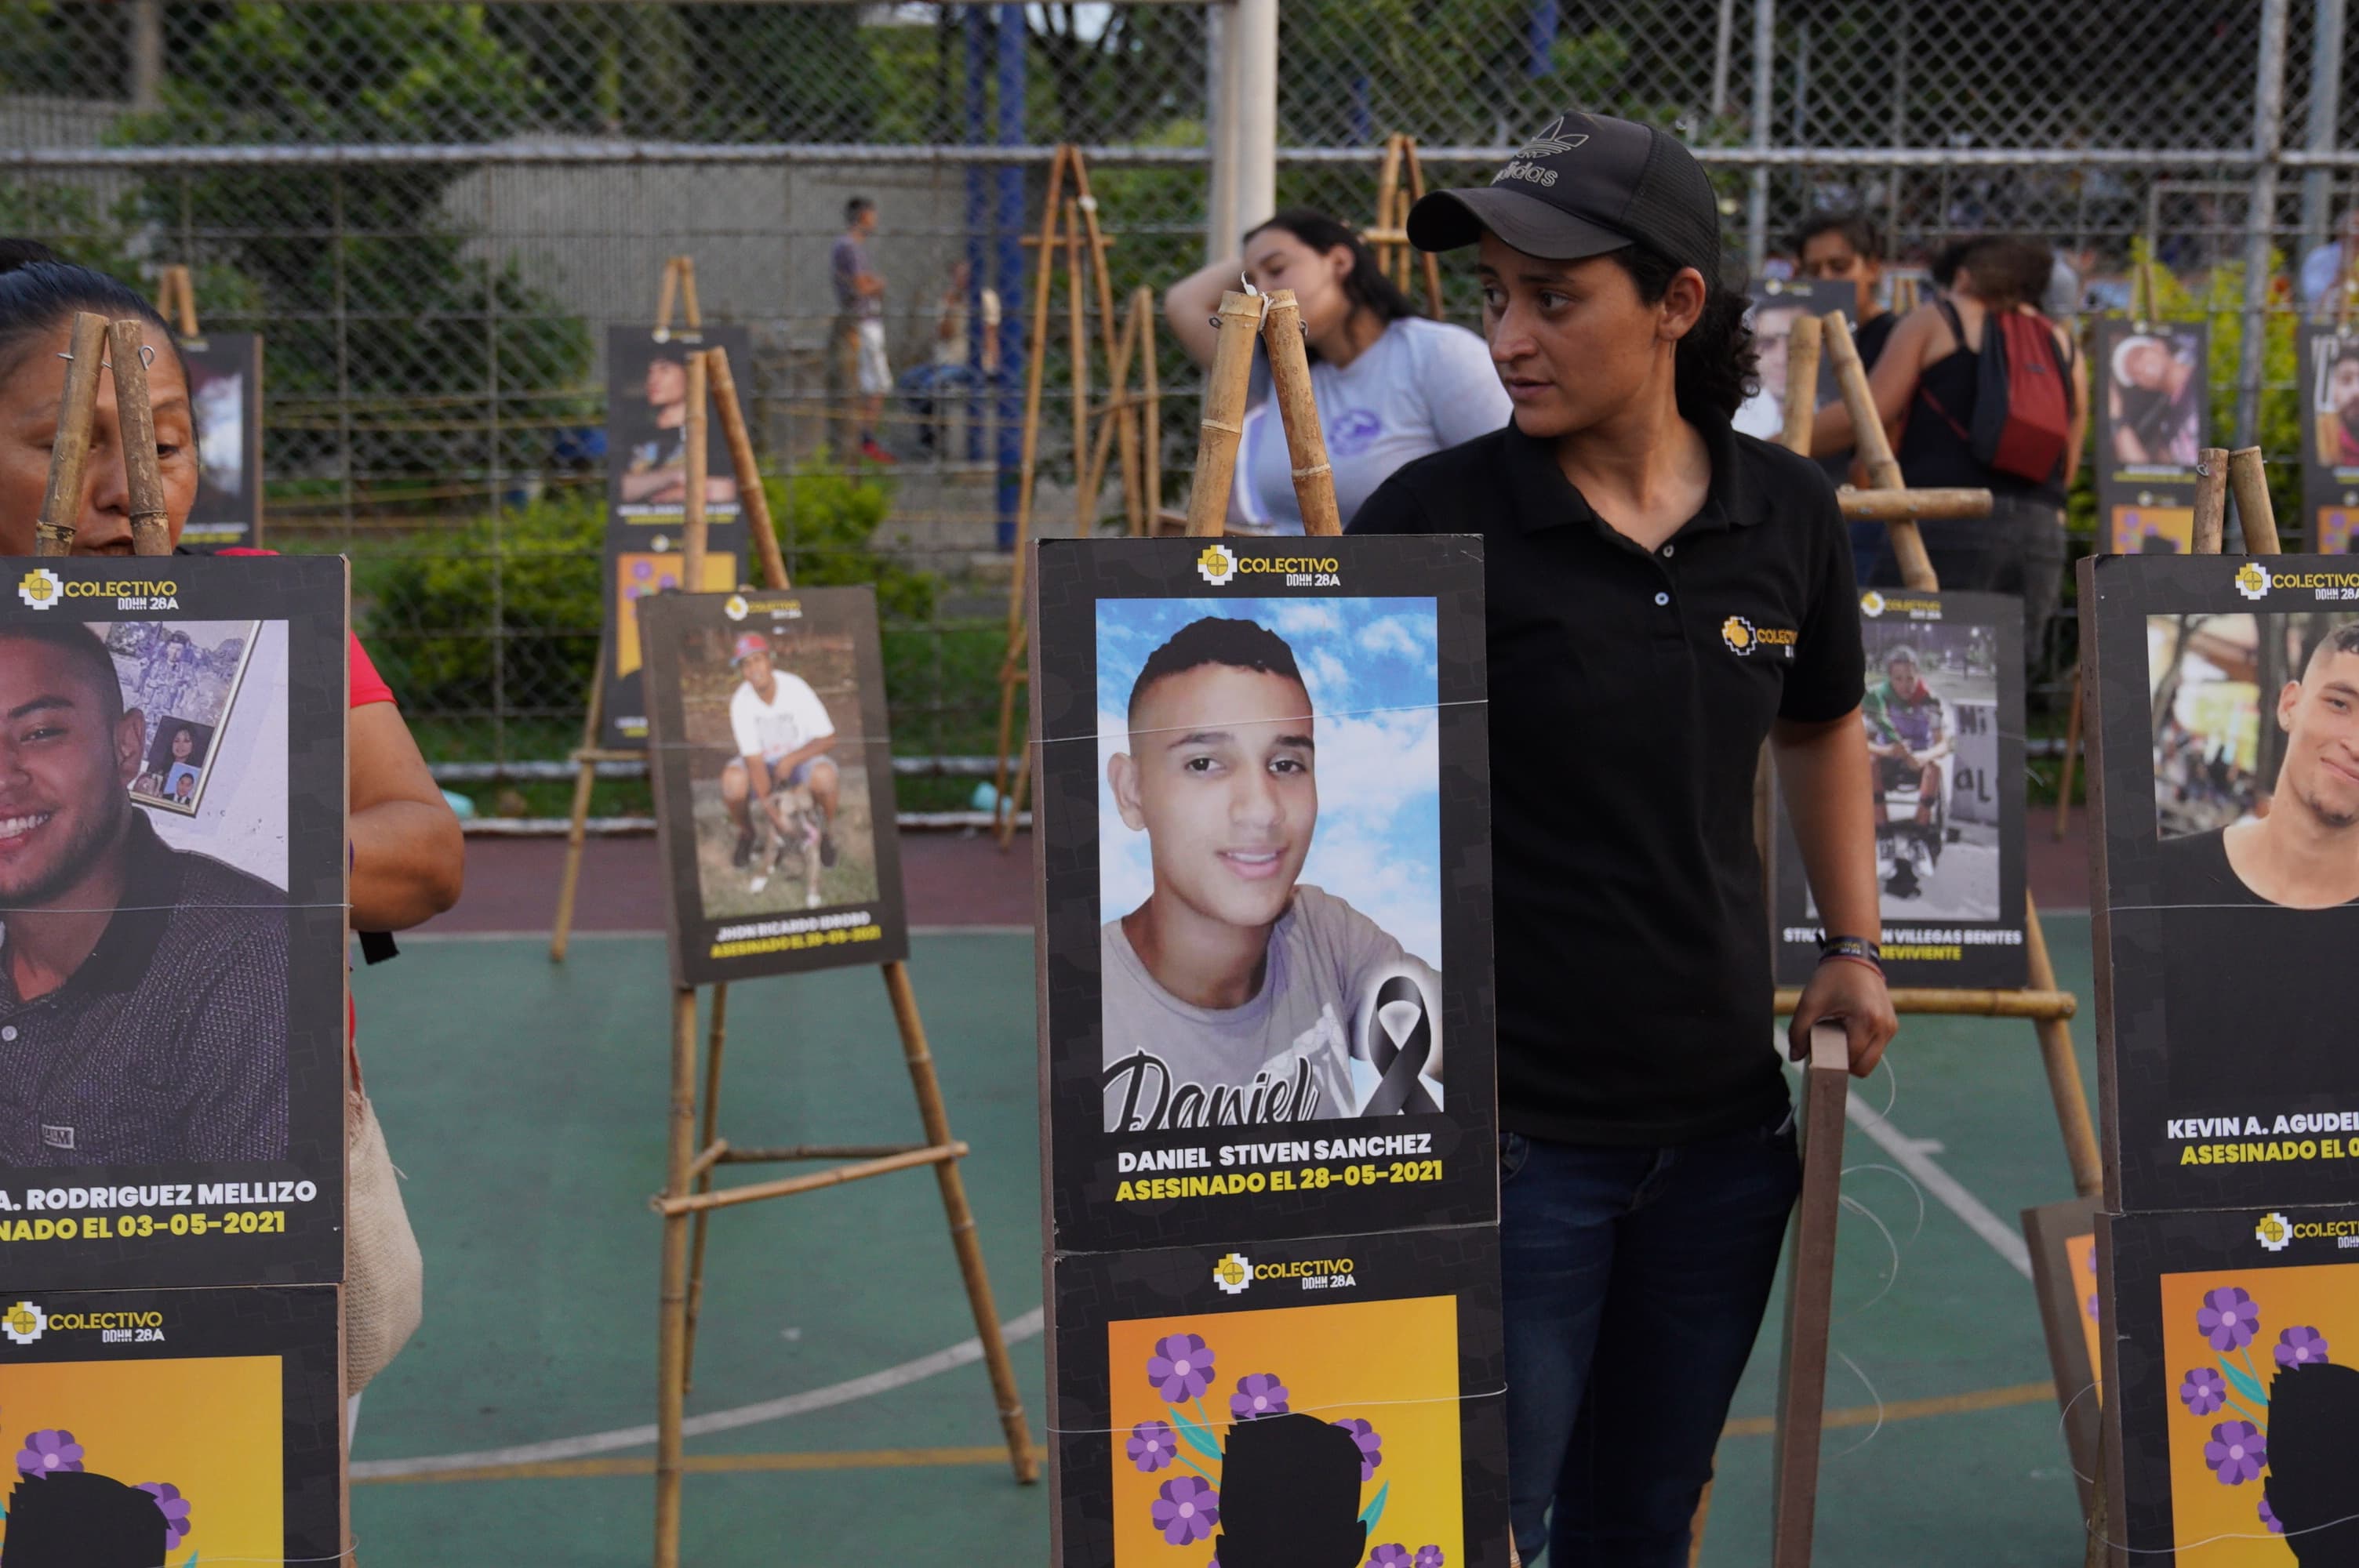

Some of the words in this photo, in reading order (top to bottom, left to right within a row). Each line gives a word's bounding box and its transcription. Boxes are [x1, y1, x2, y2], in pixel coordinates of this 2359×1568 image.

[1239, 557, 1339, 574] COLECTIVO
[65, 580, 177, 597] COLECTIVO
[1286, 574, 1312, 586] DDHH
[1314, 573, 1341, 586] 28A
[2272, 573, 2359, 589] COLECTIVO
[118, 597, 147, 610] DDHH
[149, 597, 179, 610] 28A
[2315, 588, 2339, 601] DDHH
[710, 936, 791, 959] ASESINADO
[791, 933, 805, 950] EL
[1894, 928, 1963, 945] VILLEGAS
[1963, 928, 2023, 946] BENITES
[1879, 944, 1962, 961] REVIVIENTE
[1103, 1046, 1320, 1133] Daniel
[2167, 1116, 2241, 1139] KEVIN
[2244, 1116, 2269, 1136] A.
[1118, 1147, 1212, 1173] DANIEL
[1219, 1141, 1310, 1167] STIVEN
[1314, 1133, 1432, 1160] SANCHEZ
[2179, 1140, 2317, 1166] ASESINADO
[2321, 1138, 2346, 1159] EL
[1114, 1171, 1266, 1202] ASESINADO
[1270, 1170, 1297, 1192] EL
[1299, 1159, 1442, 1189] 28-05-2021
[27, 1184, 192, 1210] RODRIGUEZ
[198, 1180, 318, 1205] MELLIZO
[82, 1217, 113, 1239] EL
[118, 1210, 285, 1237] 03-05-2021
[1255, 1258, 1354, 1279] COLECTIVO
[1302, 1276, 1329, 1290] DDHH
[1329, 1273, 1356, 1288] 28A
[48, 1311, 163, 1331] COLECTIVO
[102, 1329, 133, 1343] DDHH
[135, 1328, 165, 1342] 28A
